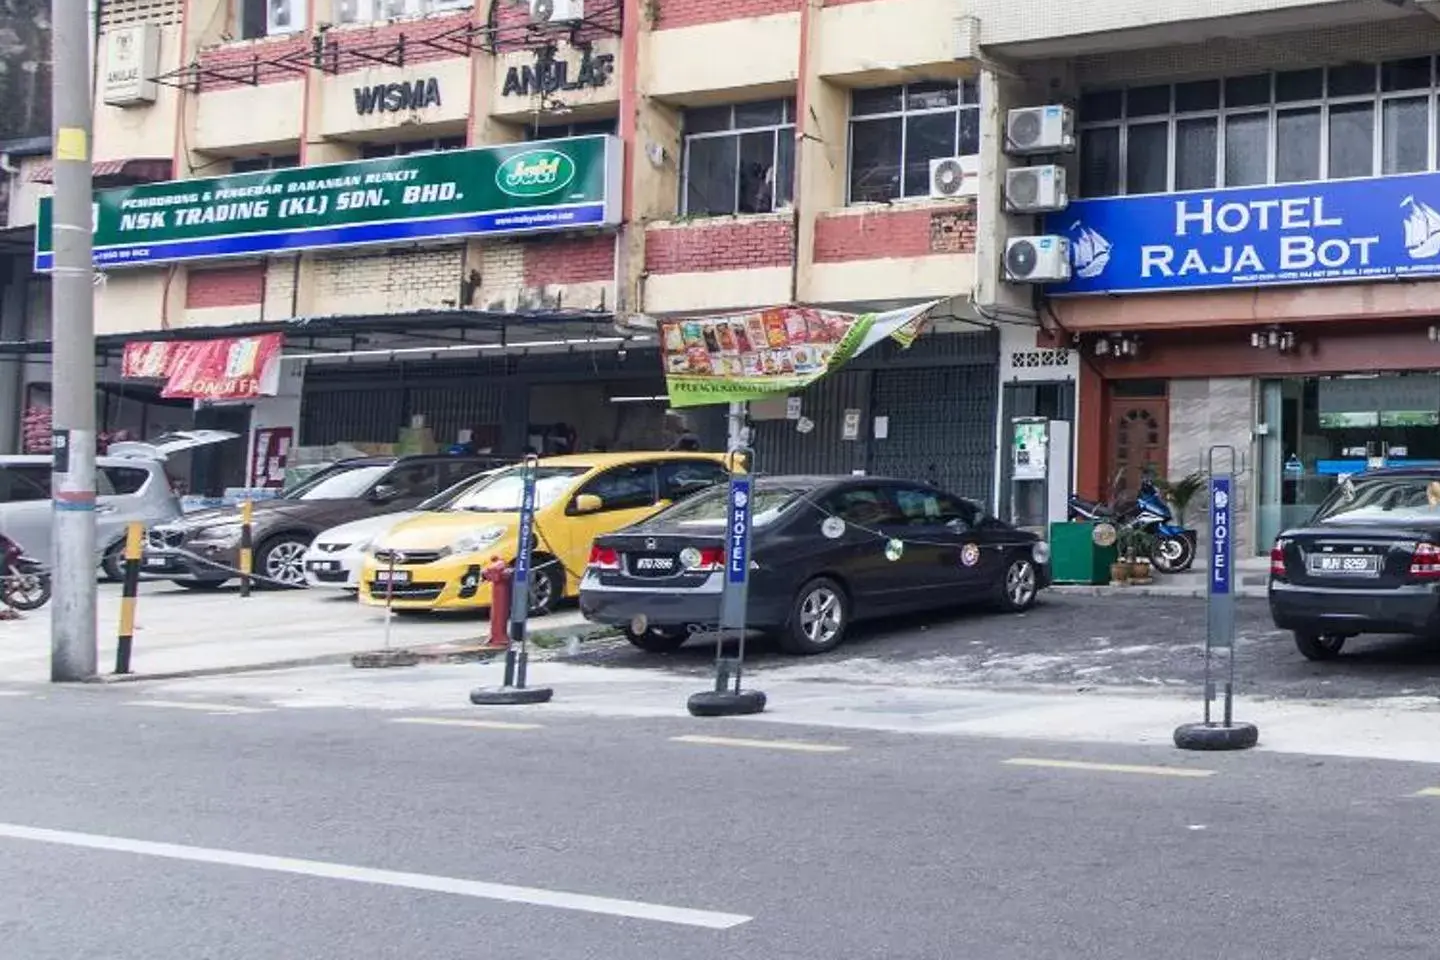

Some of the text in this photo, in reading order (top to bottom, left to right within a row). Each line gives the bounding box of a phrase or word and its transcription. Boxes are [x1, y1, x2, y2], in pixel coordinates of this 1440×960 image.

[354, 77, 441, 115] WISMA
[119, 181, 464, 231] NSK TRADING (KL) SDN. BHD.
[202, 192, 211, 201] &
[364, 169, 419, 184] RUNCIT
[732, 510, 746, 572] HOTEL
[1214, 511, 1227, 581] HOTEL
